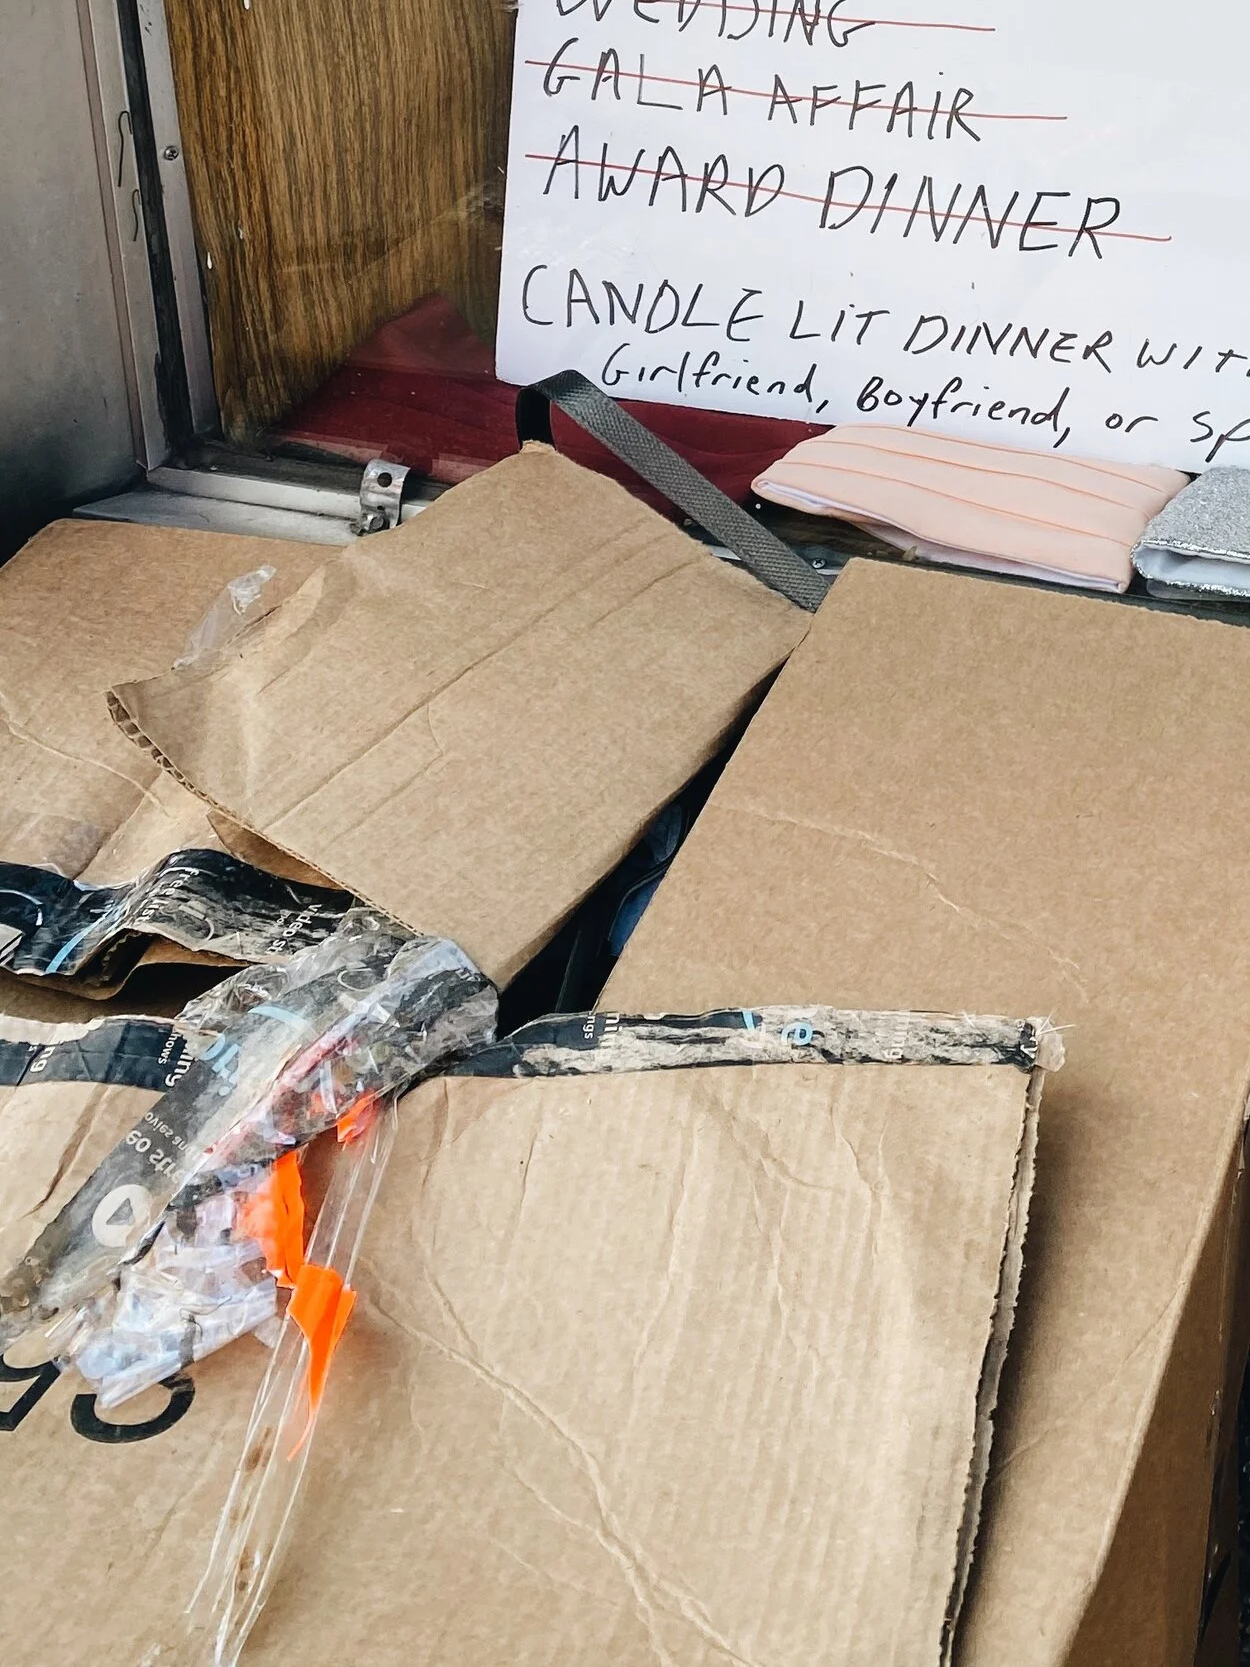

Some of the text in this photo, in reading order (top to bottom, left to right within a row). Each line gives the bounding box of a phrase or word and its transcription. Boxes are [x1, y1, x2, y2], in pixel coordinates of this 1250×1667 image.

[543, 38, 731, 115] GALA
[543, 125, 1122, 259] AWARD DINNER
[522, 264, 764, 343] CANDLE
[903, 314, 1113, 374] DINNER
[601, 343, 829, 414] Girlfriend,
[857, 376, 1071, 448] Boyfriend,
[1105, 411, 1159, 434] or
[157, 1032, 179, 1065] hows
